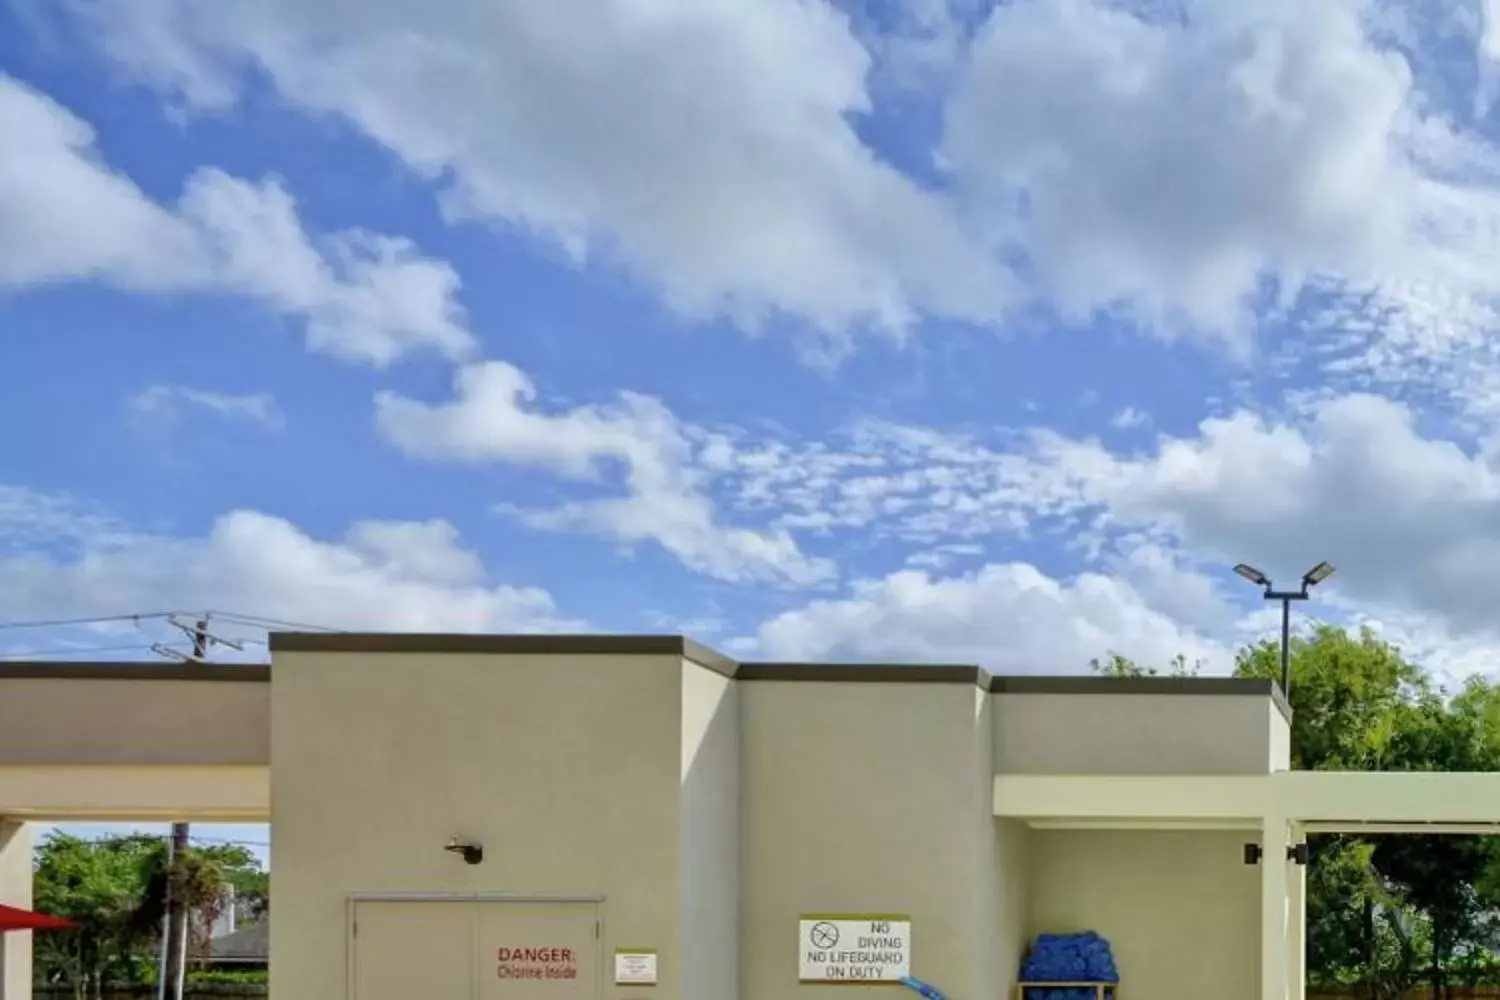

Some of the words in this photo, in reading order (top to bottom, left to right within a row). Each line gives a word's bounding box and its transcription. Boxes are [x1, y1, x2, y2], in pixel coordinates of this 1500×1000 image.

[872, 922, 890, 933] NO
[858, 937, 902, 949] DIVING
[807, 952, 826, 963] NO
[830, 952, 903, 963] LIFEGUARD
[498, 965, 543, 979] Chlorine
[545, 965, 577, 979] Inside
[826, 967, 845, 978] ON
[850, 967, 884, 978] DUTY
